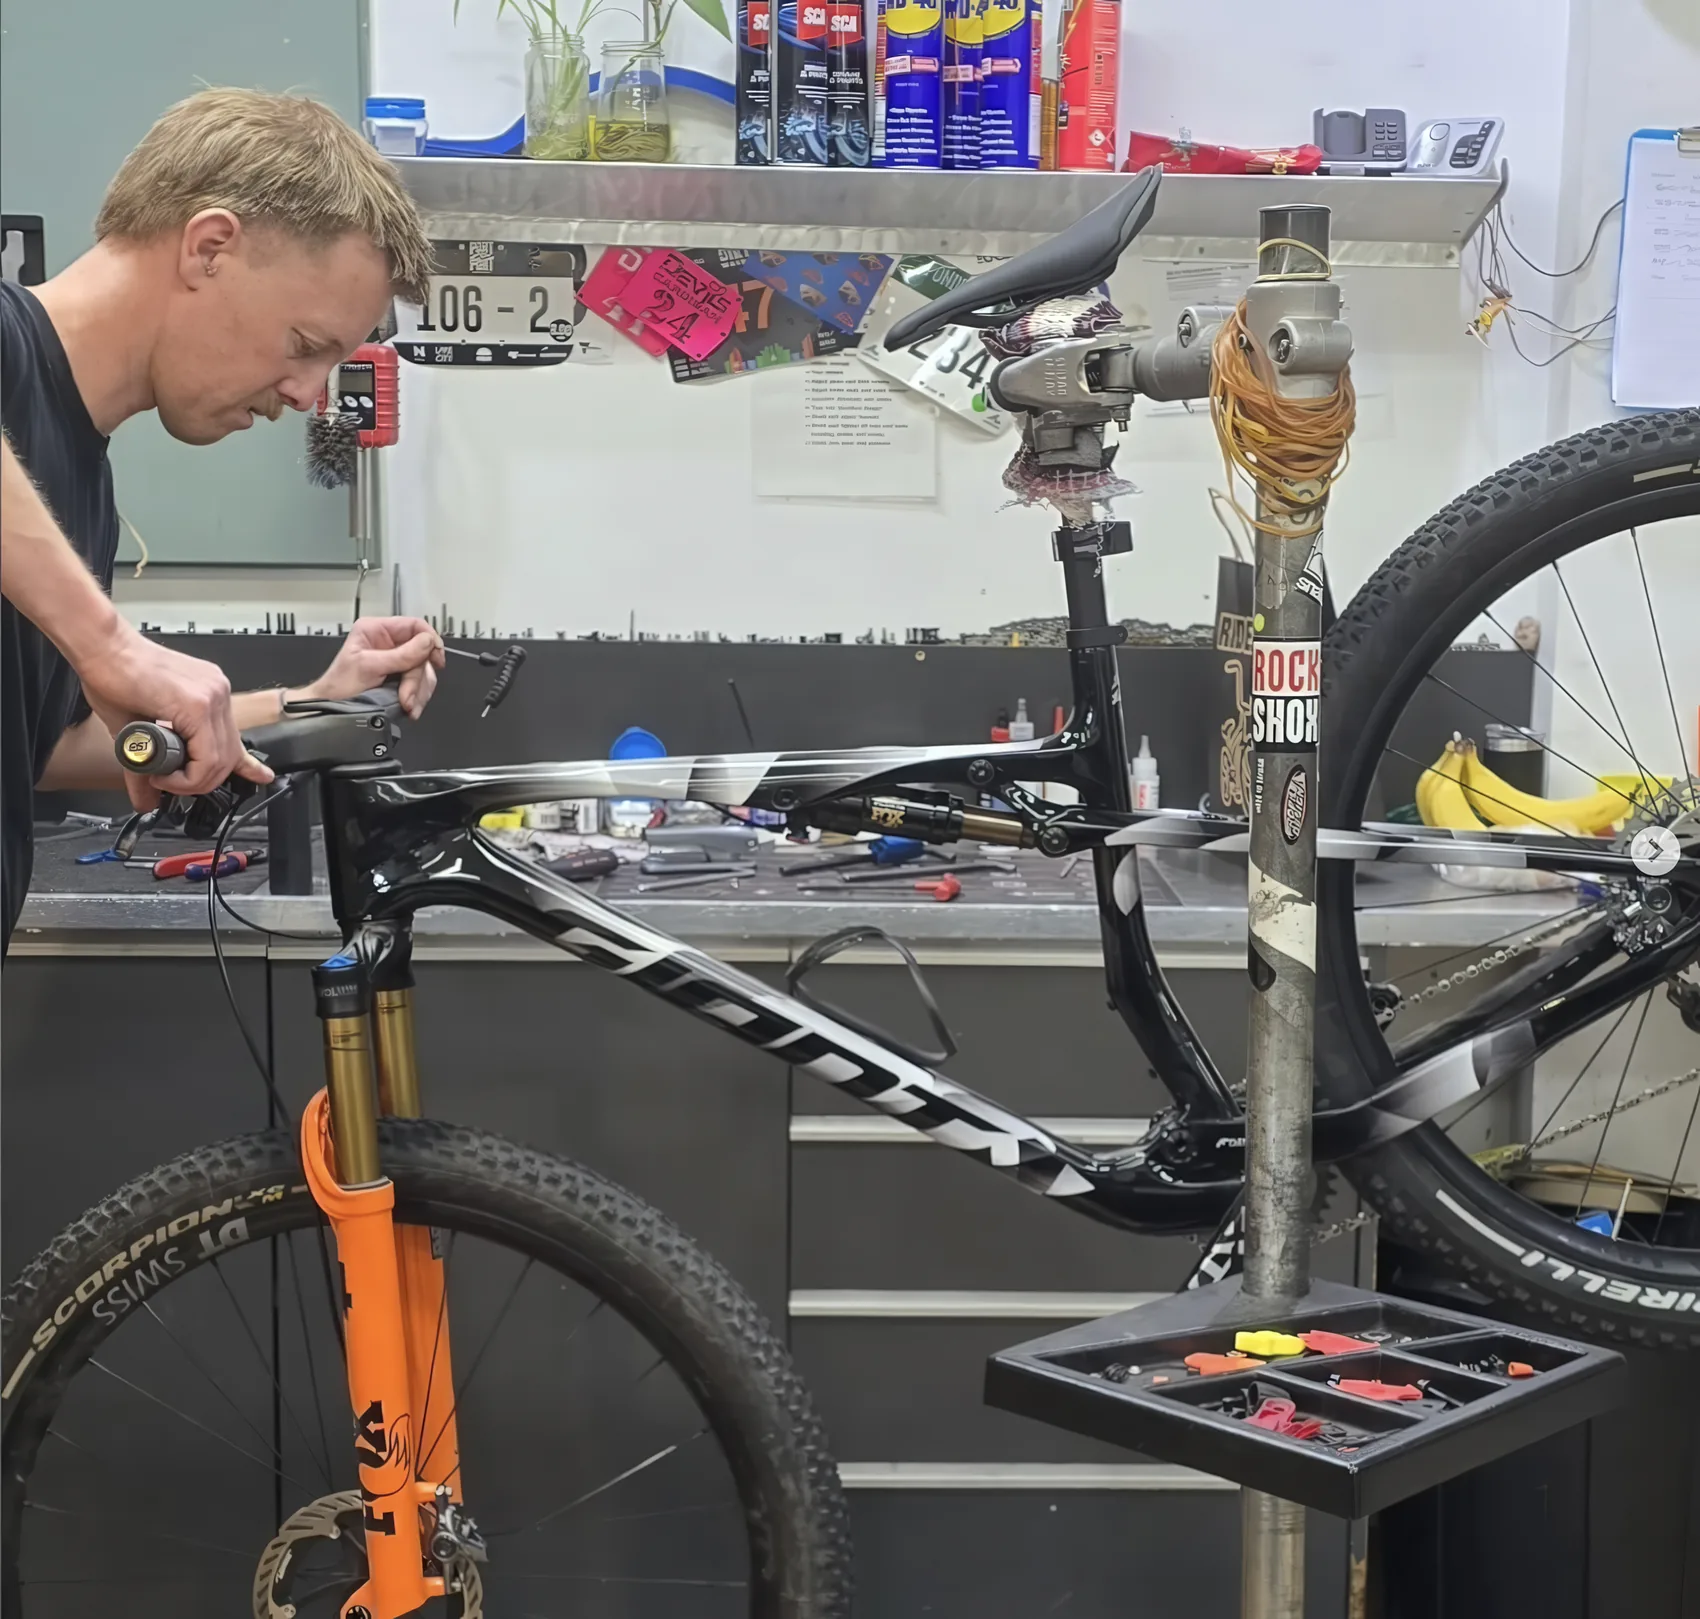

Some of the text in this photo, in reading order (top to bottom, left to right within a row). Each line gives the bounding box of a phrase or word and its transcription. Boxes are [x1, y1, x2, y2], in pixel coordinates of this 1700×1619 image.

[753, 13, 769, 31] SC
[417, 285, 482, 332] 106
[639, 289, 700, 345] 24
[1254, 648, 1319, 692] ROCK
[1253, 698, 1318, 744] SHOX
[32, 1199, 233, 1352] SCORPION
[92, 1217, 250, 1326] DT SWISS
[1521, 1250, 1700, 1313] IRELLI
